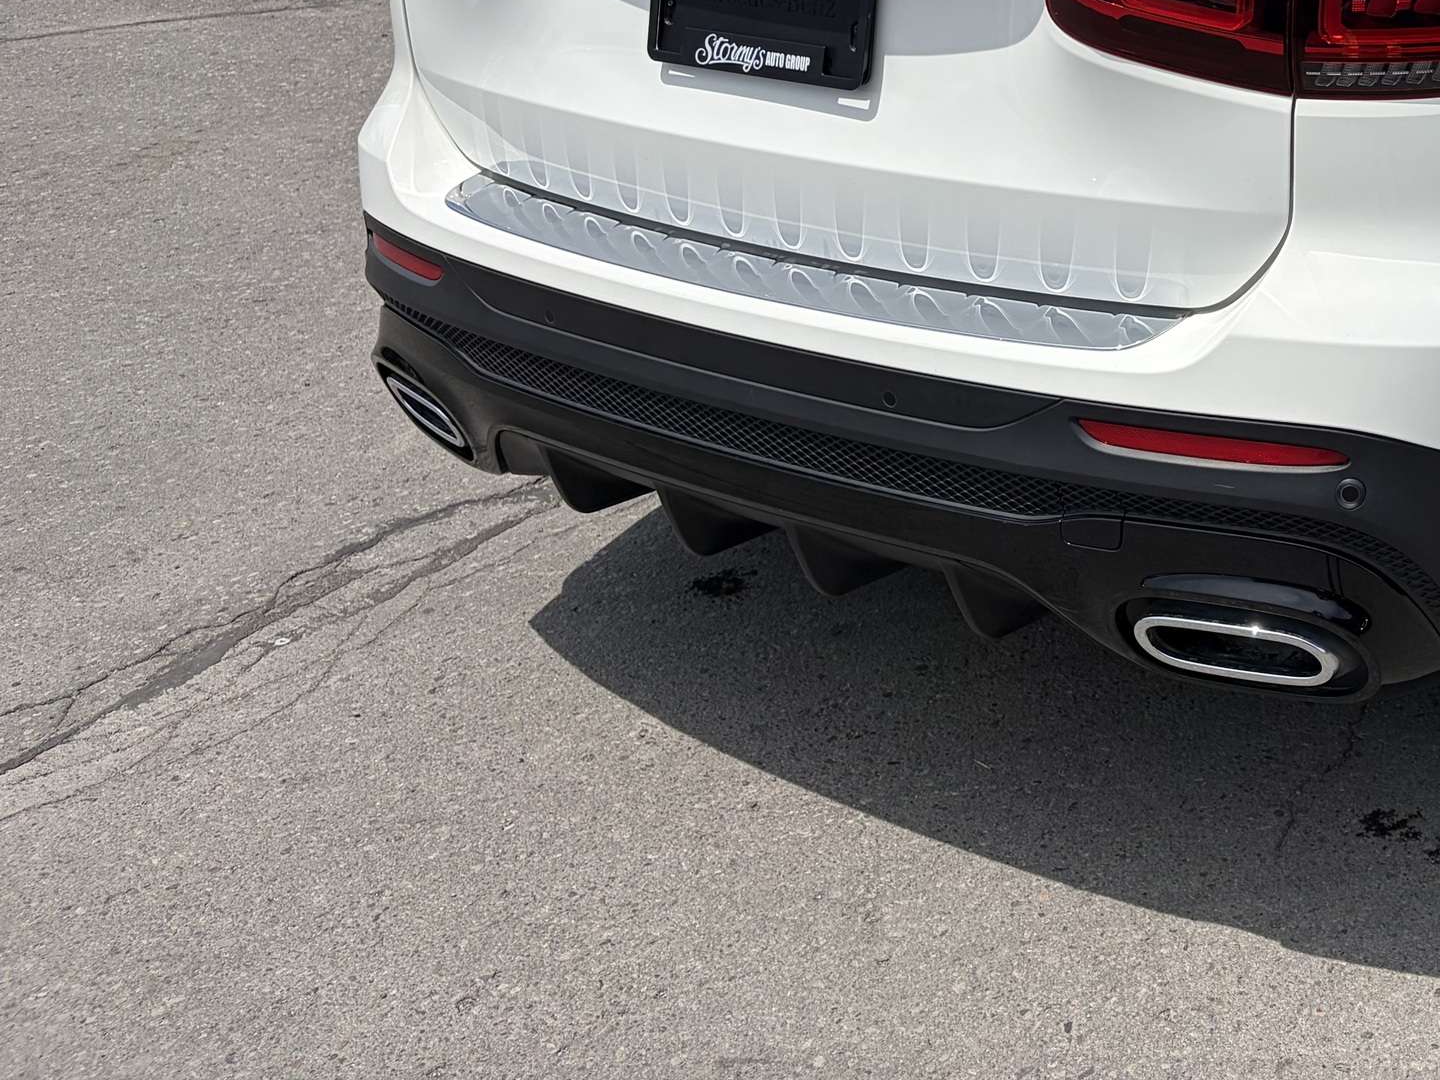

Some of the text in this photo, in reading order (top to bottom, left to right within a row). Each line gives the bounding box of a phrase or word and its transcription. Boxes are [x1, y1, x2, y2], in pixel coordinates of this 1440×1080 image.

[695, 33, 811, 72] Stormy's AUTO GROUP
